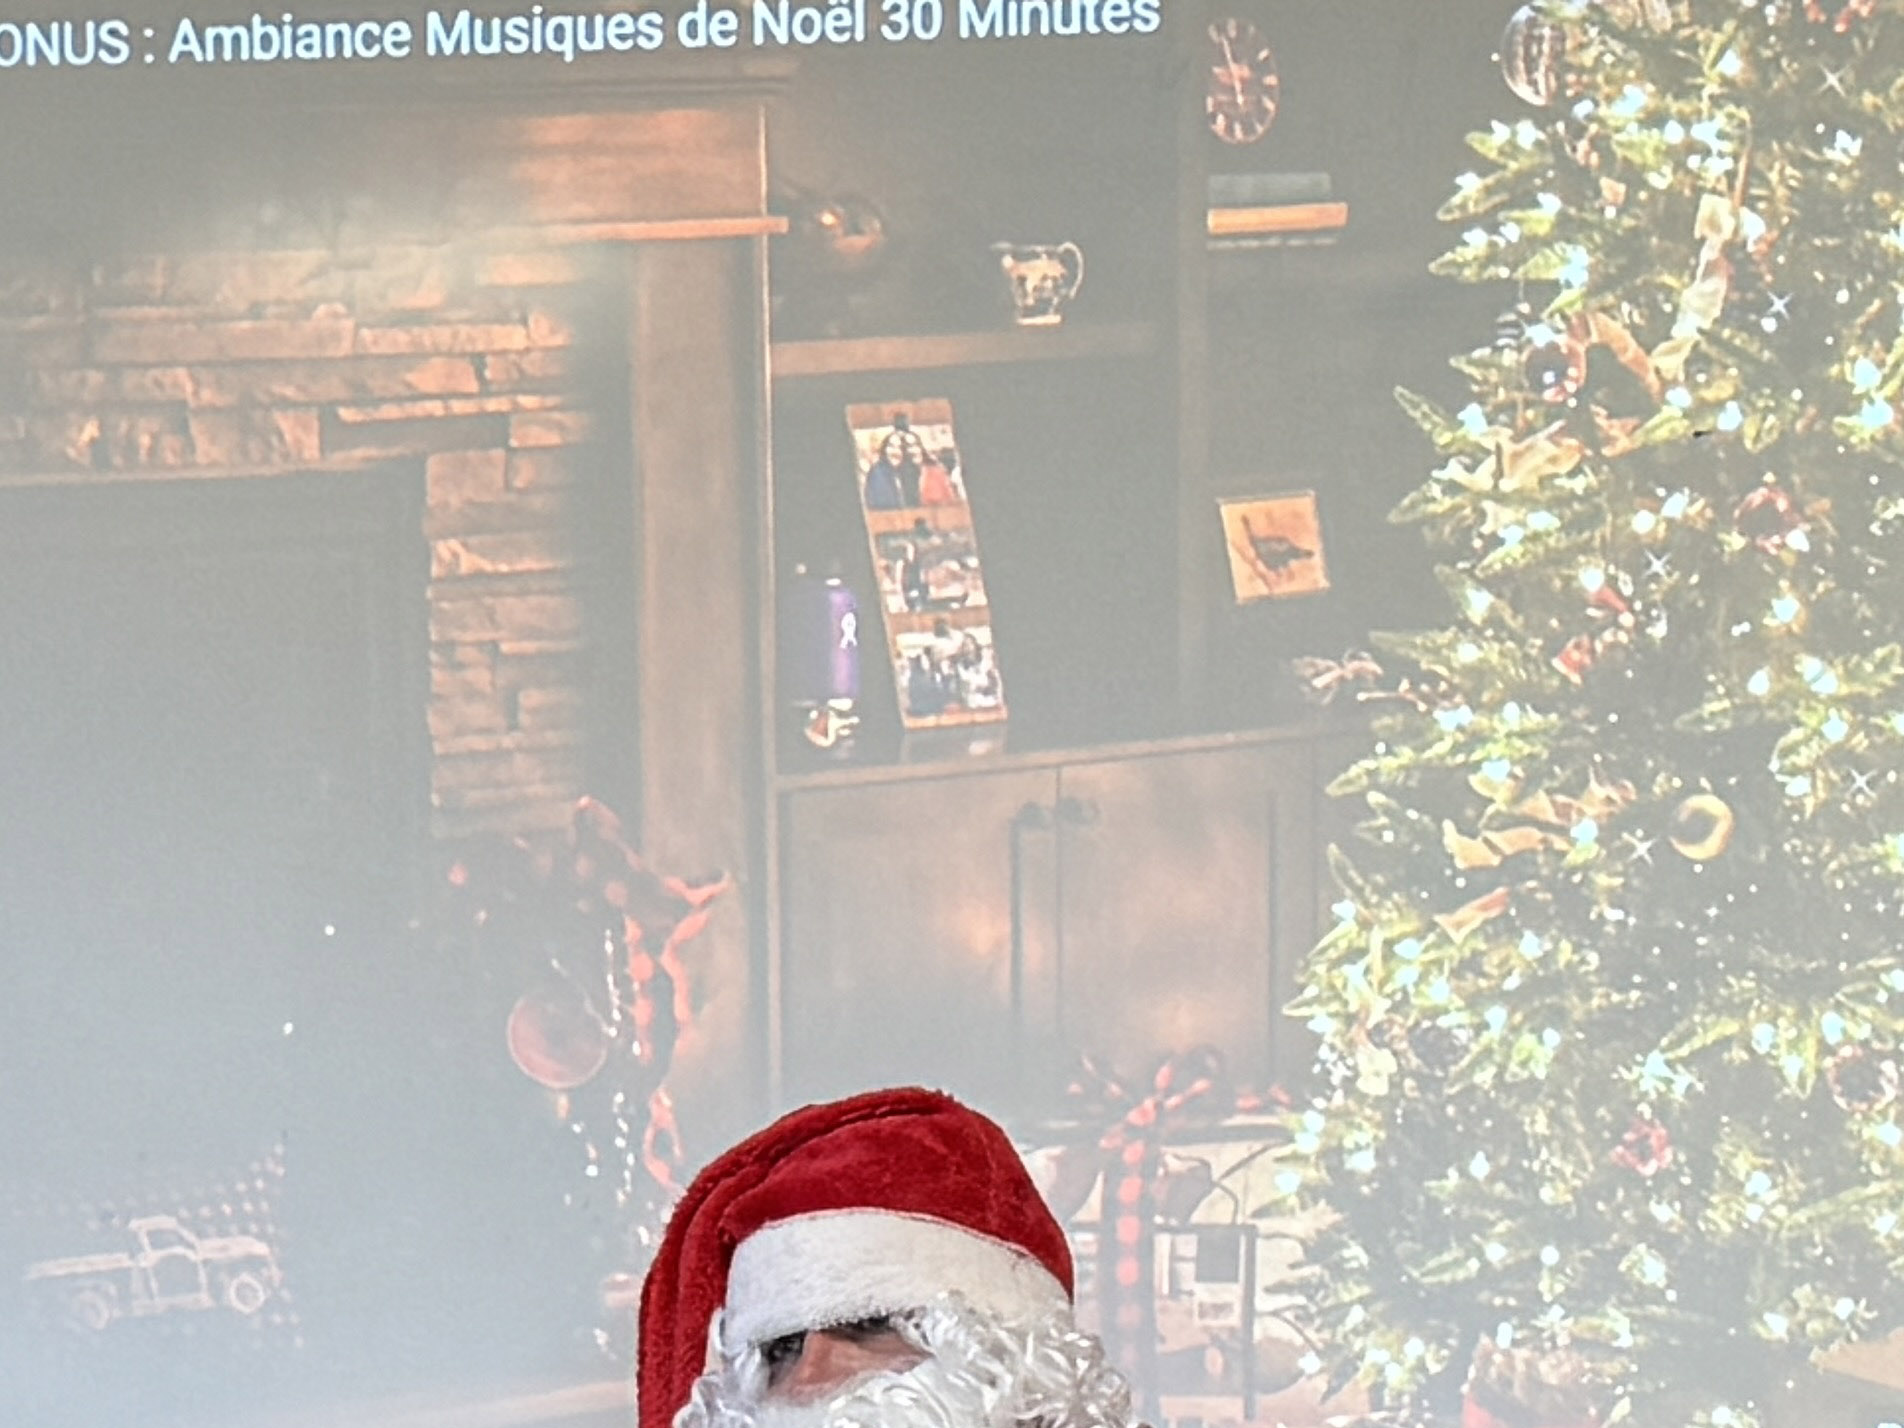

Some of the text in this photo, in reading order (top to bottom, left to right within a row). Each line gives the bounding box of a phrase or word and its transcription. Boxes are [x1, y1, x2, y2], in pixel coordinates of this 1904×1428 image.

[169, 12, 411, 64] Ambiance
[426, 5, 664, 61] Musiques
[677, 1, 738, 48] de
[752, 0, 865, 46] Noël
[882, 0, 942, 42] 30
[960, 0, 1161, 38] Minutes
